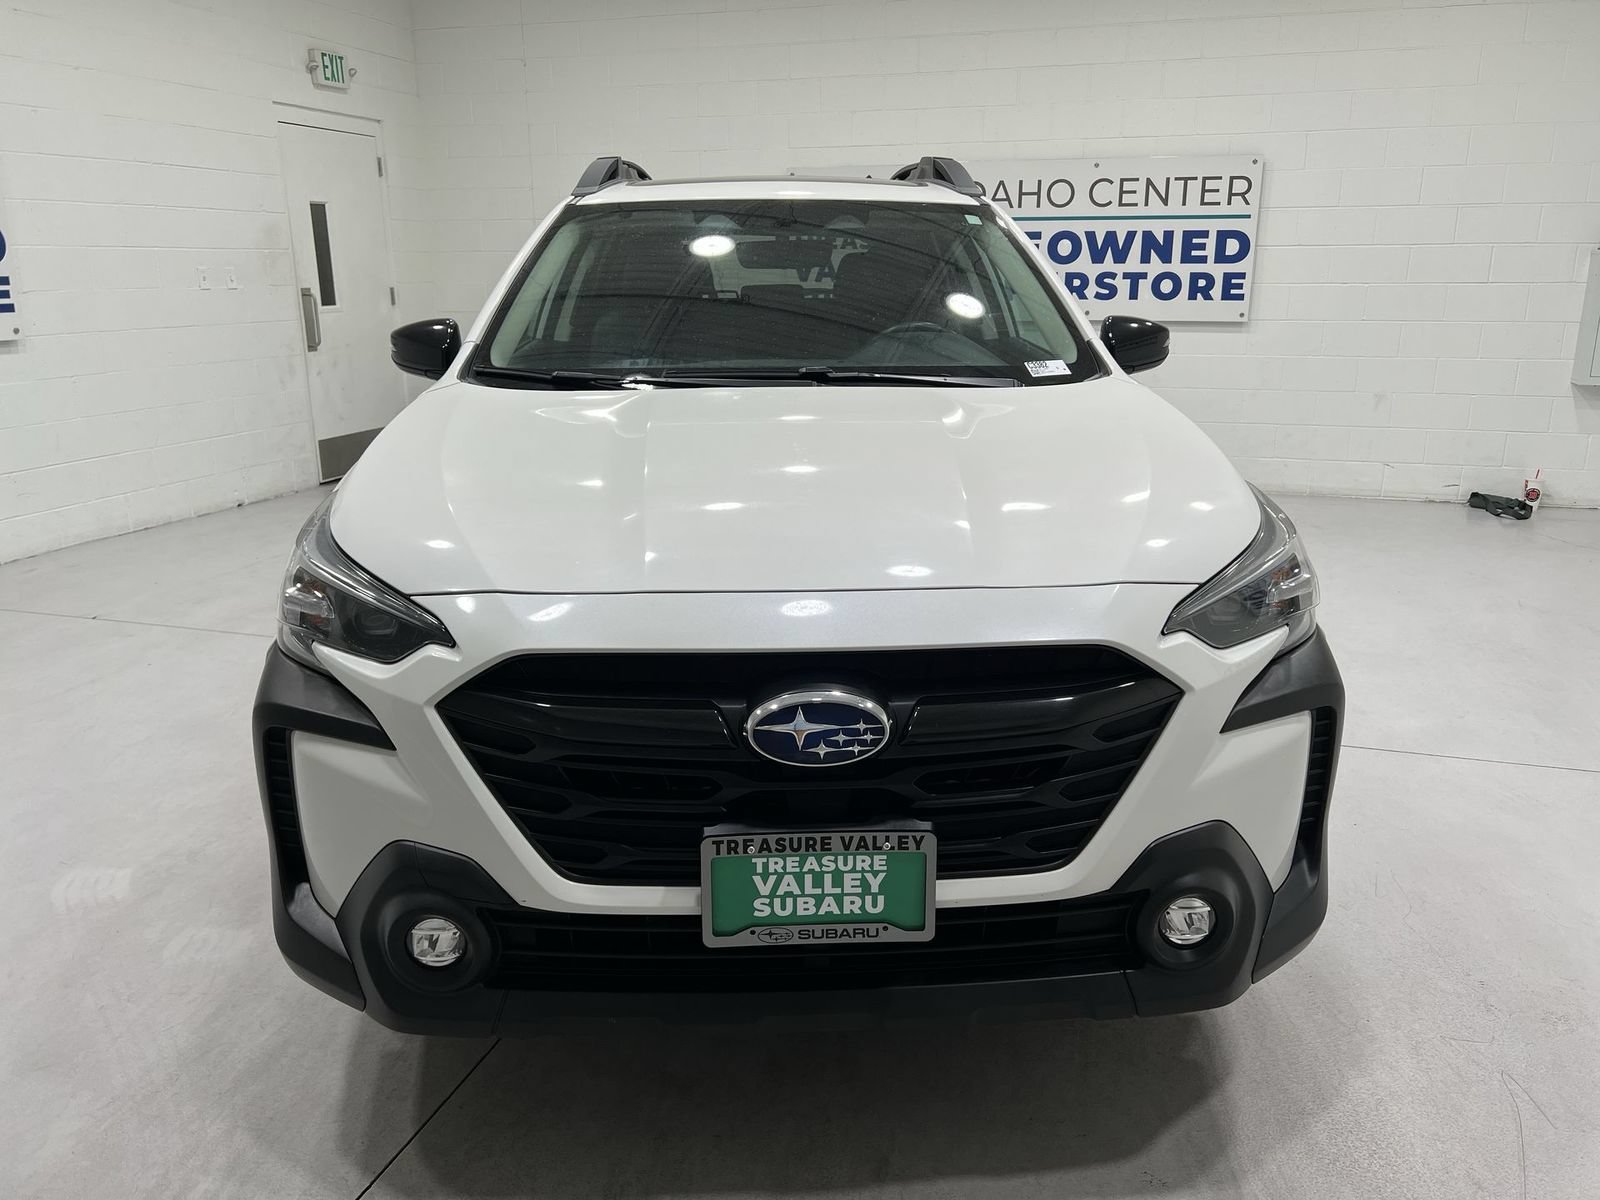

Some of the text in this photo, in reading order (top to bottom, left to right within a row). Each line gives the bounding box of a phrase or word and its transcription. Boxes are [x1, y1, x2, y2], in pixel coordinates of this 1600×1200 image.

[321, 52, 345, 84] EXIT
[1089, 175, 1253, 208] CENTER
[711, 834, 926, 856] TREASURE VALLEY
[751, 855, 888, 873] TREASURE
[752, 872, 887, 896] VALLEY
[753, 895, 886, 917] SUBARU
[797, 927, 880, 940] SUBARU
